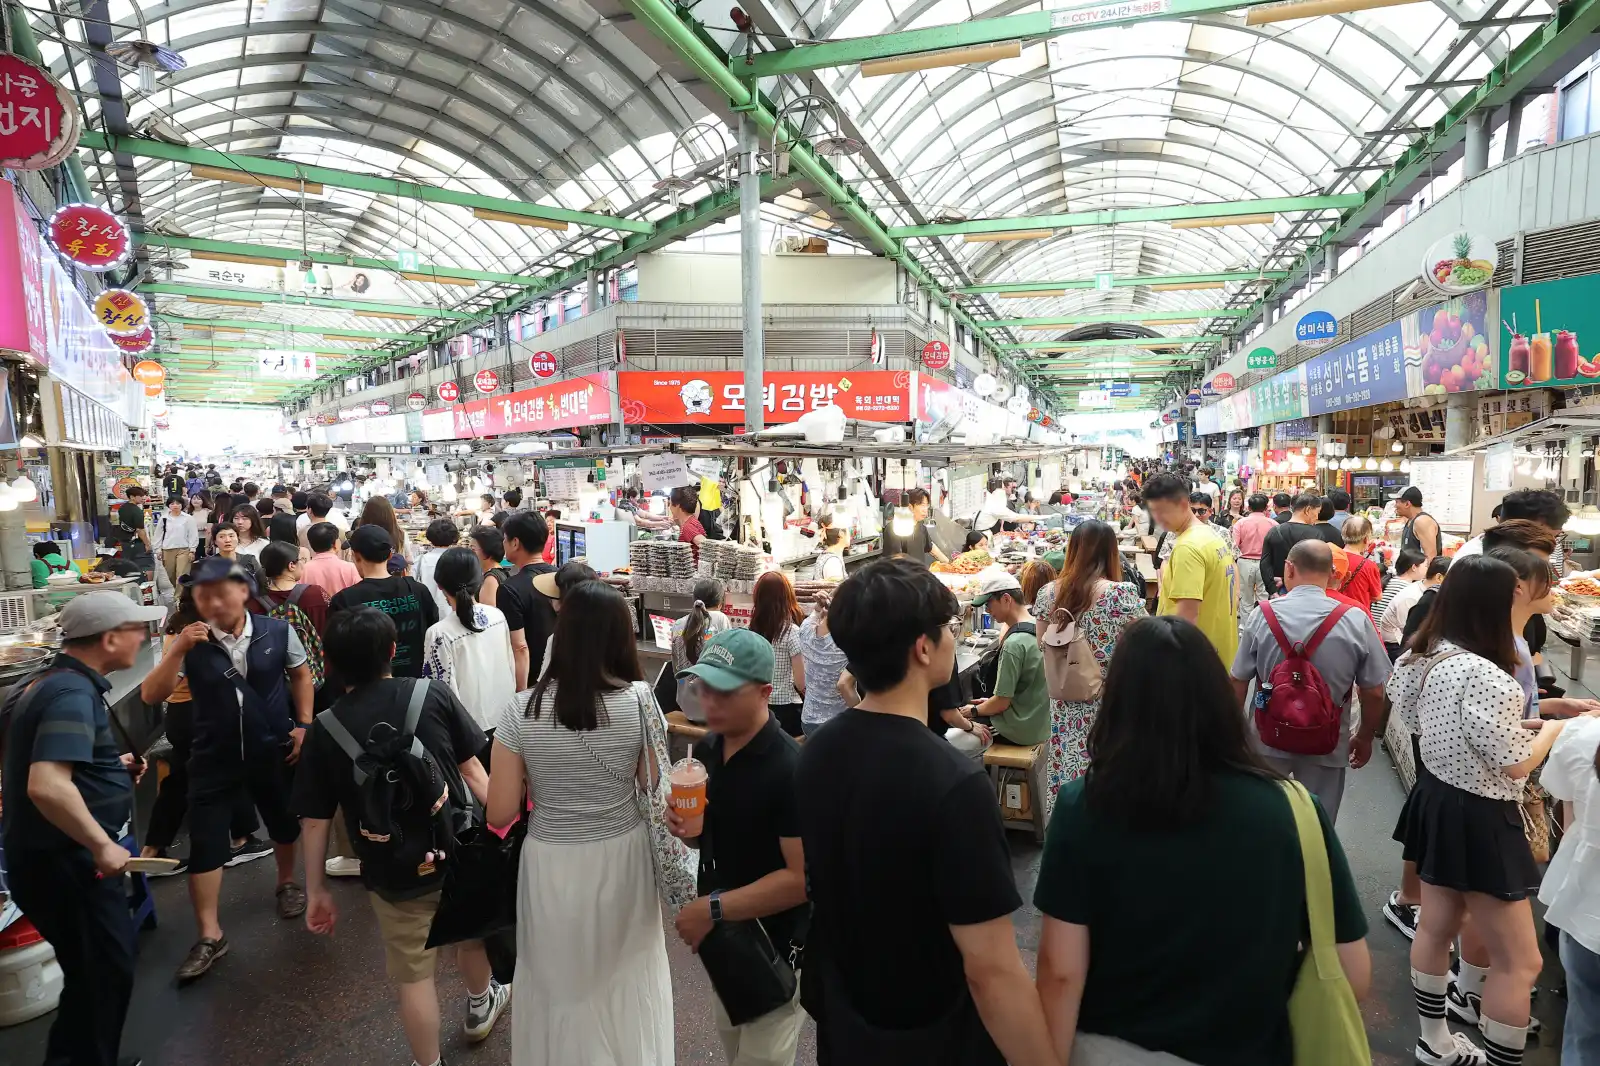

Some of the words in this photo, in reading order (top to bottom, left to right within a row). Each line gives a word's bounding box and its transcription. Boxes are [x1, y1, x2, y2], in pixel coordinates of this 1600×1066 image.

[1072, 11, 1099, 22] CCTV
[1100, 5, 1131, 18] 24시간
[1133, 1, 1161, 13] 녹화중
[76, 217, 123, 239] 창신
[208, 268, 246, 283] 국순당
[102, 308, 143, 326] 창신
[1298, 321, 1335, 336] 성미식품
[533, 361, 555, 372] 빈대떡
[1323, 347, 1369, 392] 성미식품
[560, 387, 588, 418] 빈대떡
